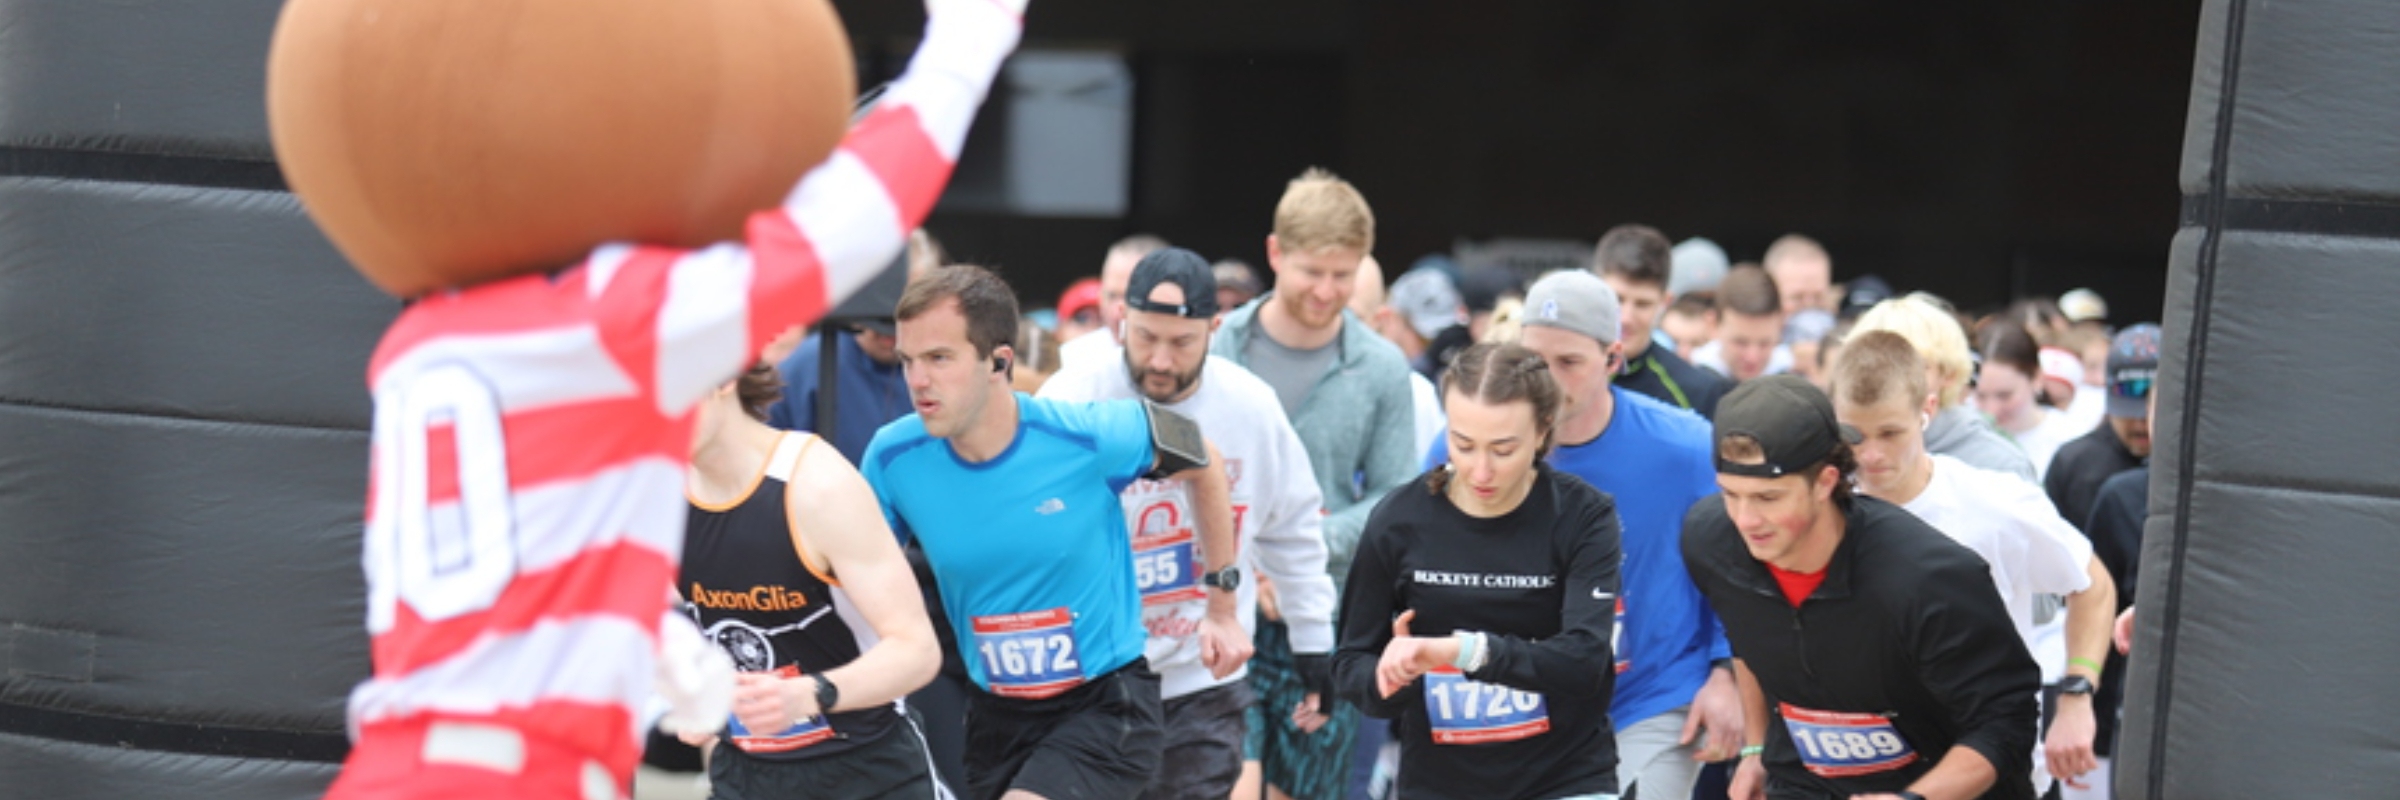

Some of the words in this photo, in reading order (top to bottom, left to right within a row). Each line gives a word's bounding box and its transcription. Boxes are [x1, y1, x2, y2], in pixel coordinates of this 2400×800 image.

[1414, 570, 1479, 586] BUCKEYE
[691, 581, 808, 611] AxonGlia
[981, 634, 1078, 676] 1672
[1794, 728, 1904, 760] 1689
